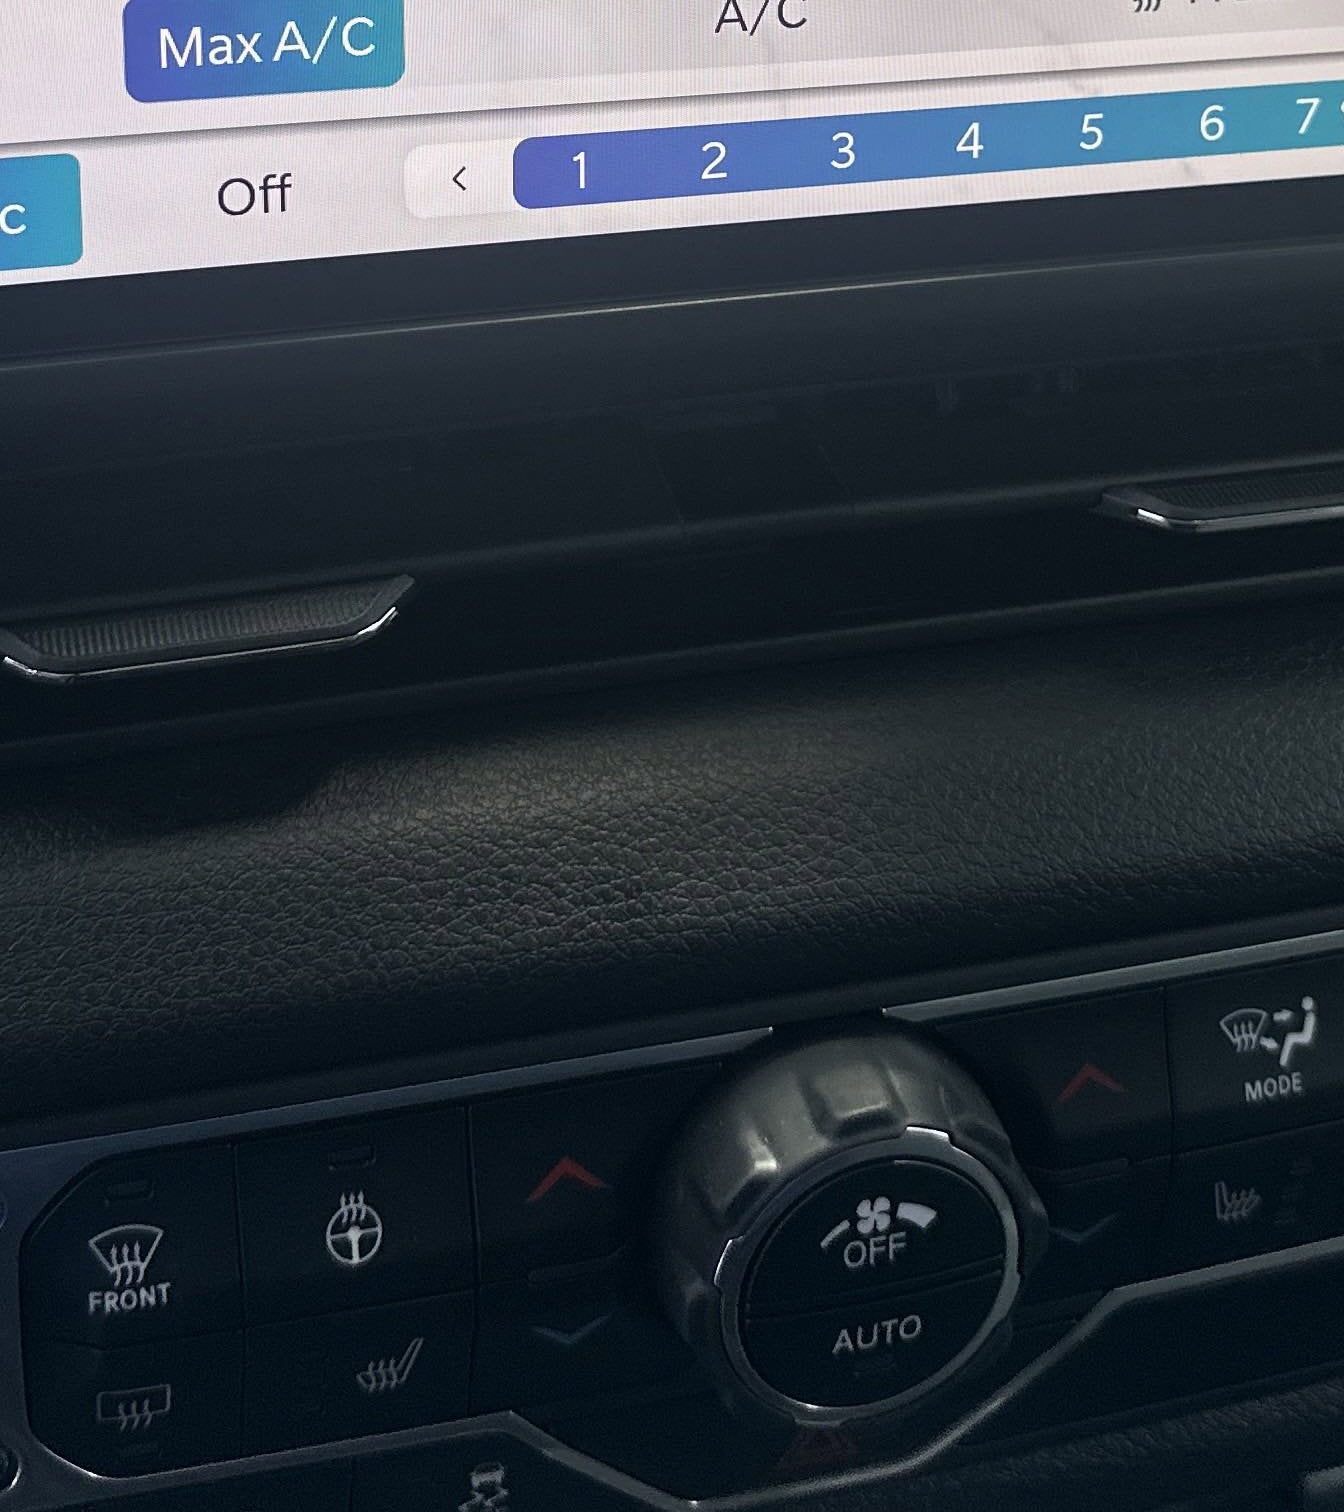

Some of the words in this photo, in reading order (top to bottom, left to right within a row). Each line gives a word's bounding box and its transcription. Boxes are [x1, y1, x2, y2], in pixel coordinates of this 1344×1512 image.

[158, 25, 262, 70] Max
[273, 15, 377, 65] A/C
[571, 150, 588, 190] 1
[700, 141, 729, 180] 2
[830, 132, 856, 169] 3
[955, 122, 985, 160] 4
[1078, 113, 1104, 151] 5
[1199, 104, 1226, 142] 6
[1295, 97, 1321, 136] 7
[216, 171, 293, 218] Off
[1244, 1071, 1303, 1102] MODE
[843, 1236, 907, 1269] OFF
[87, 1282, 171, 1315] FRONT
[832, 1313, 923, 1356] AUTO
